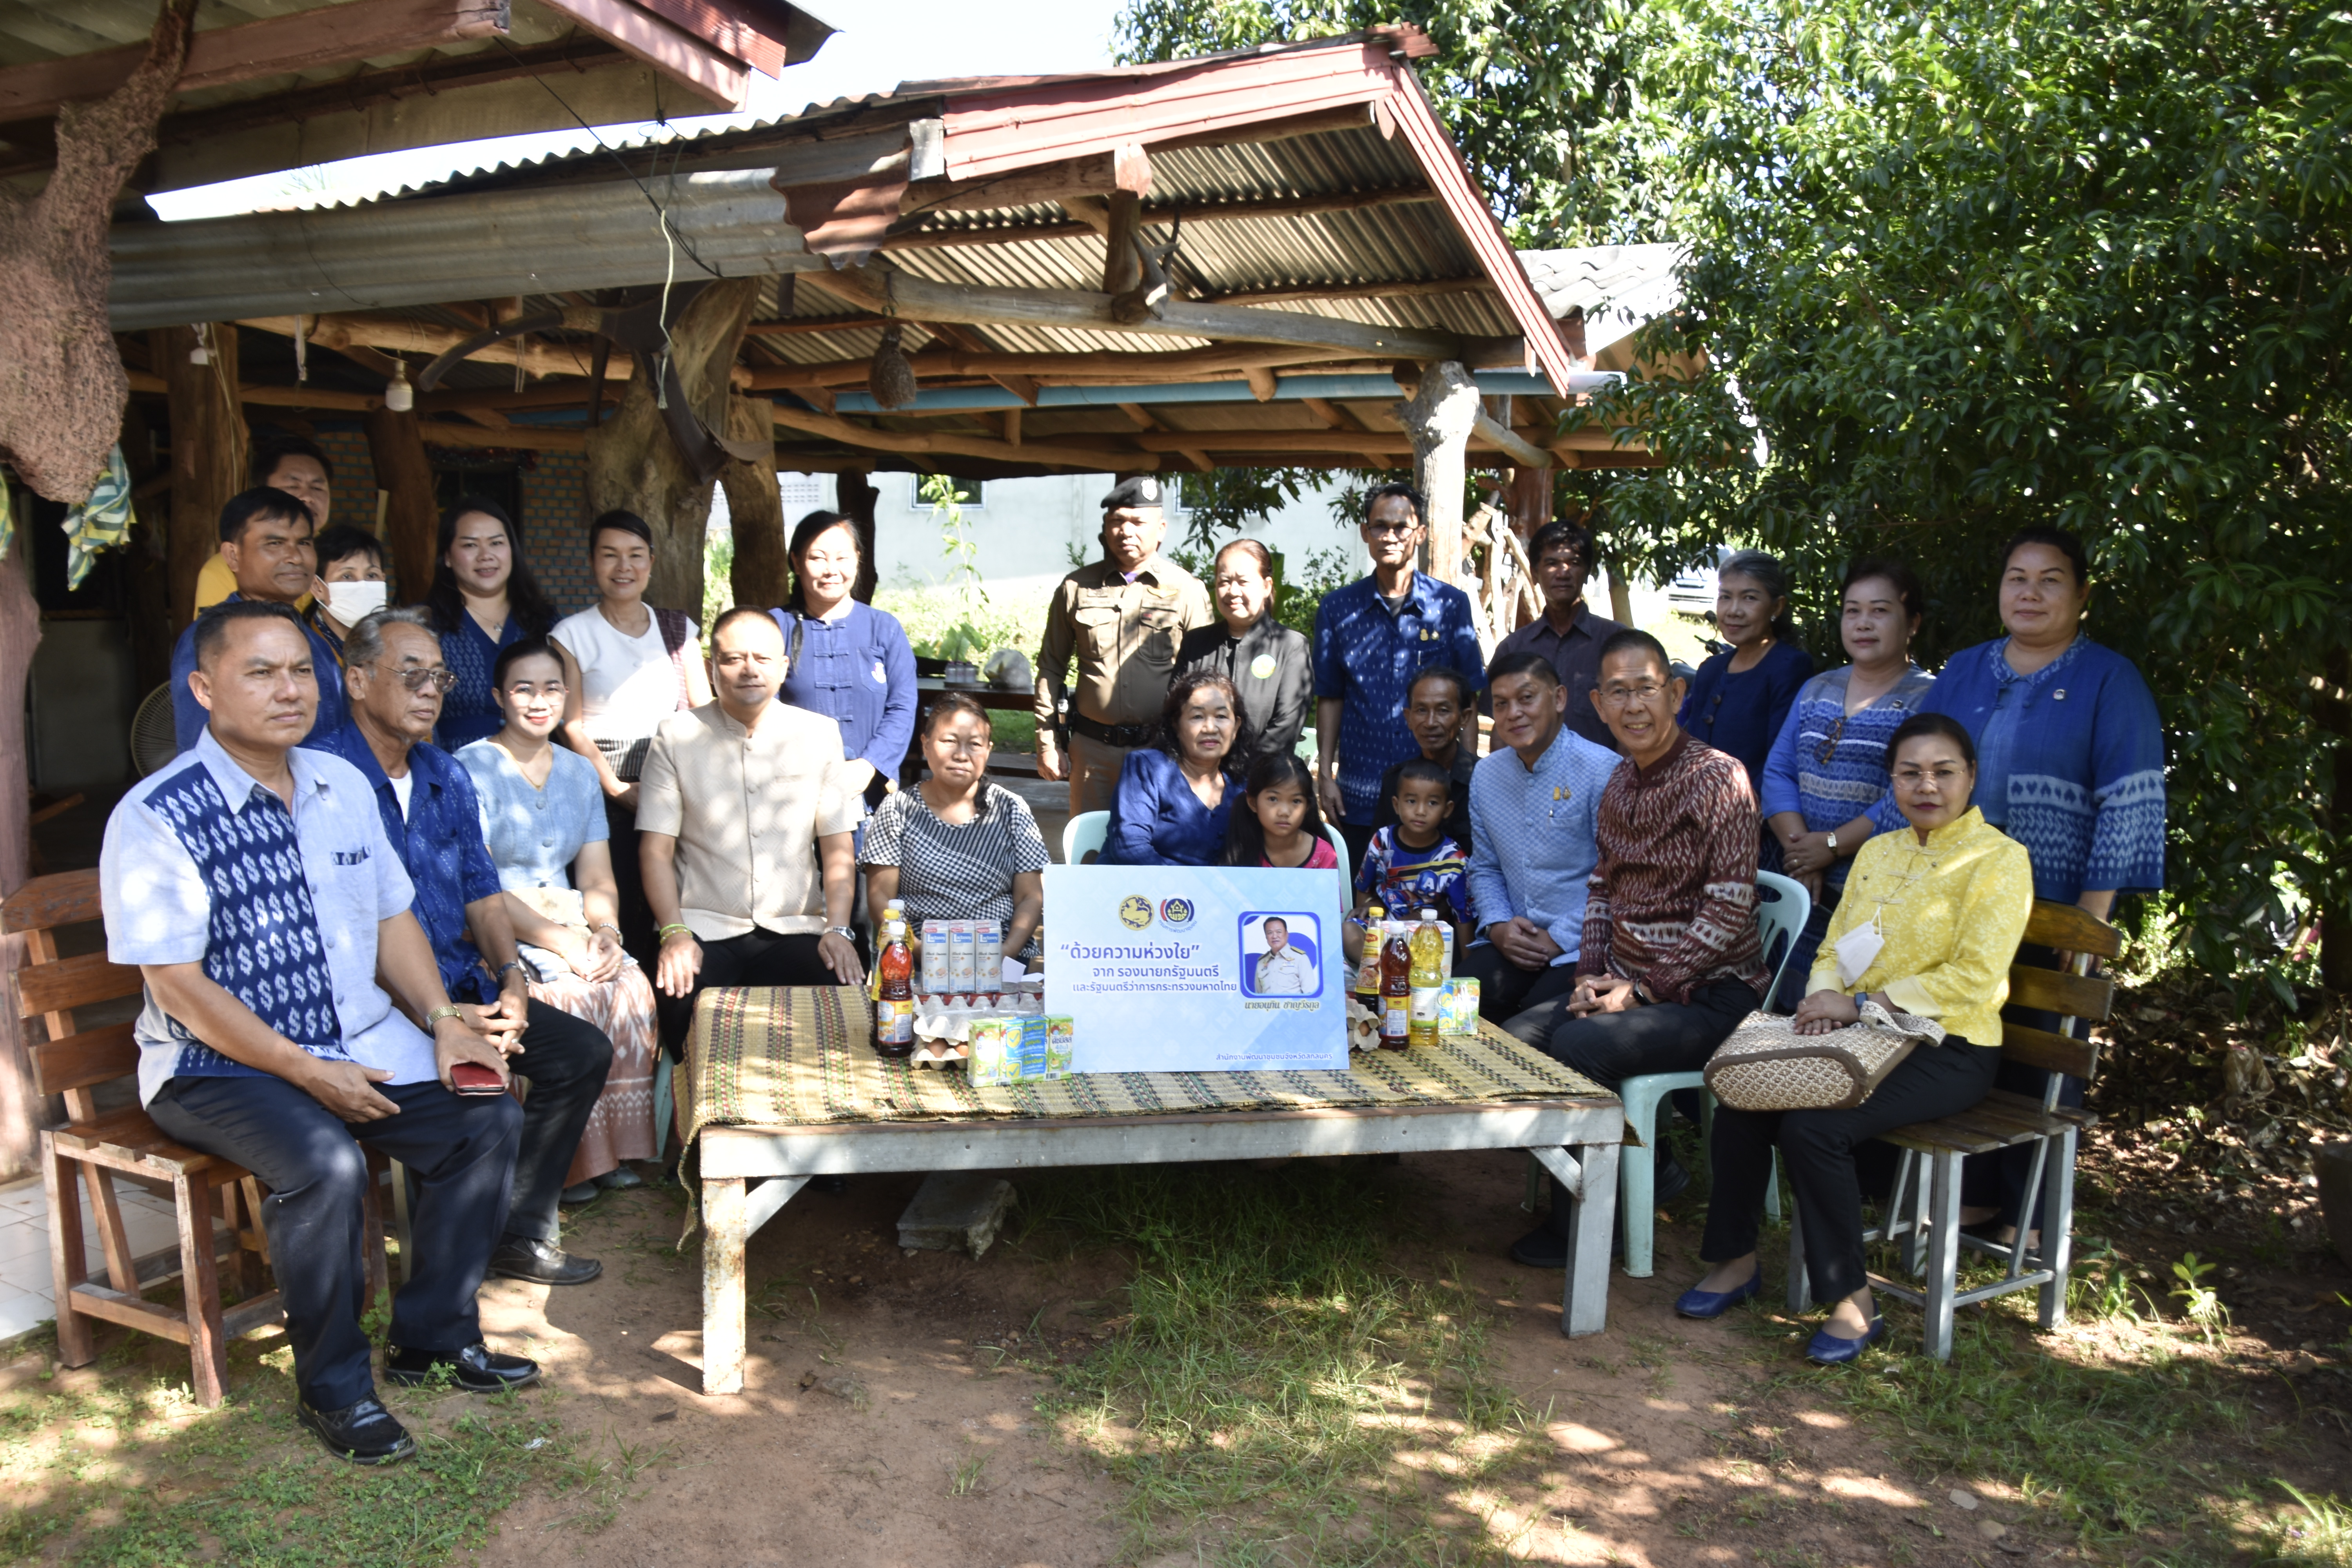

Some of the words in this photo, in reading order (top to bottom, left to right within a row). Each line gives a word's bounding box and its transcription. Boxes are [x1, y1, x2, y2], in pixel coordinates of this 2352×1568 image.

[1060, 942, 1200, 959] “ด้วยความห่วงใย”
[1093, 967, 1114, 977] จาก
[1118, 964, 1219, 980] รองนายกรัฐมนตรี
[1073, 980, 1237, 993] และรัฐมนตรีว่าการกระทรวงมหาดไทย
[1245, 1000, 1280, 1011] นายอนุทิน
[1283, 1000, 1319, 1011] ชาญวีรกูล
[1216, 1053, 1332, 1062] สำนักงานพัฒนาชุมชนจังหวัดสกลนคร
